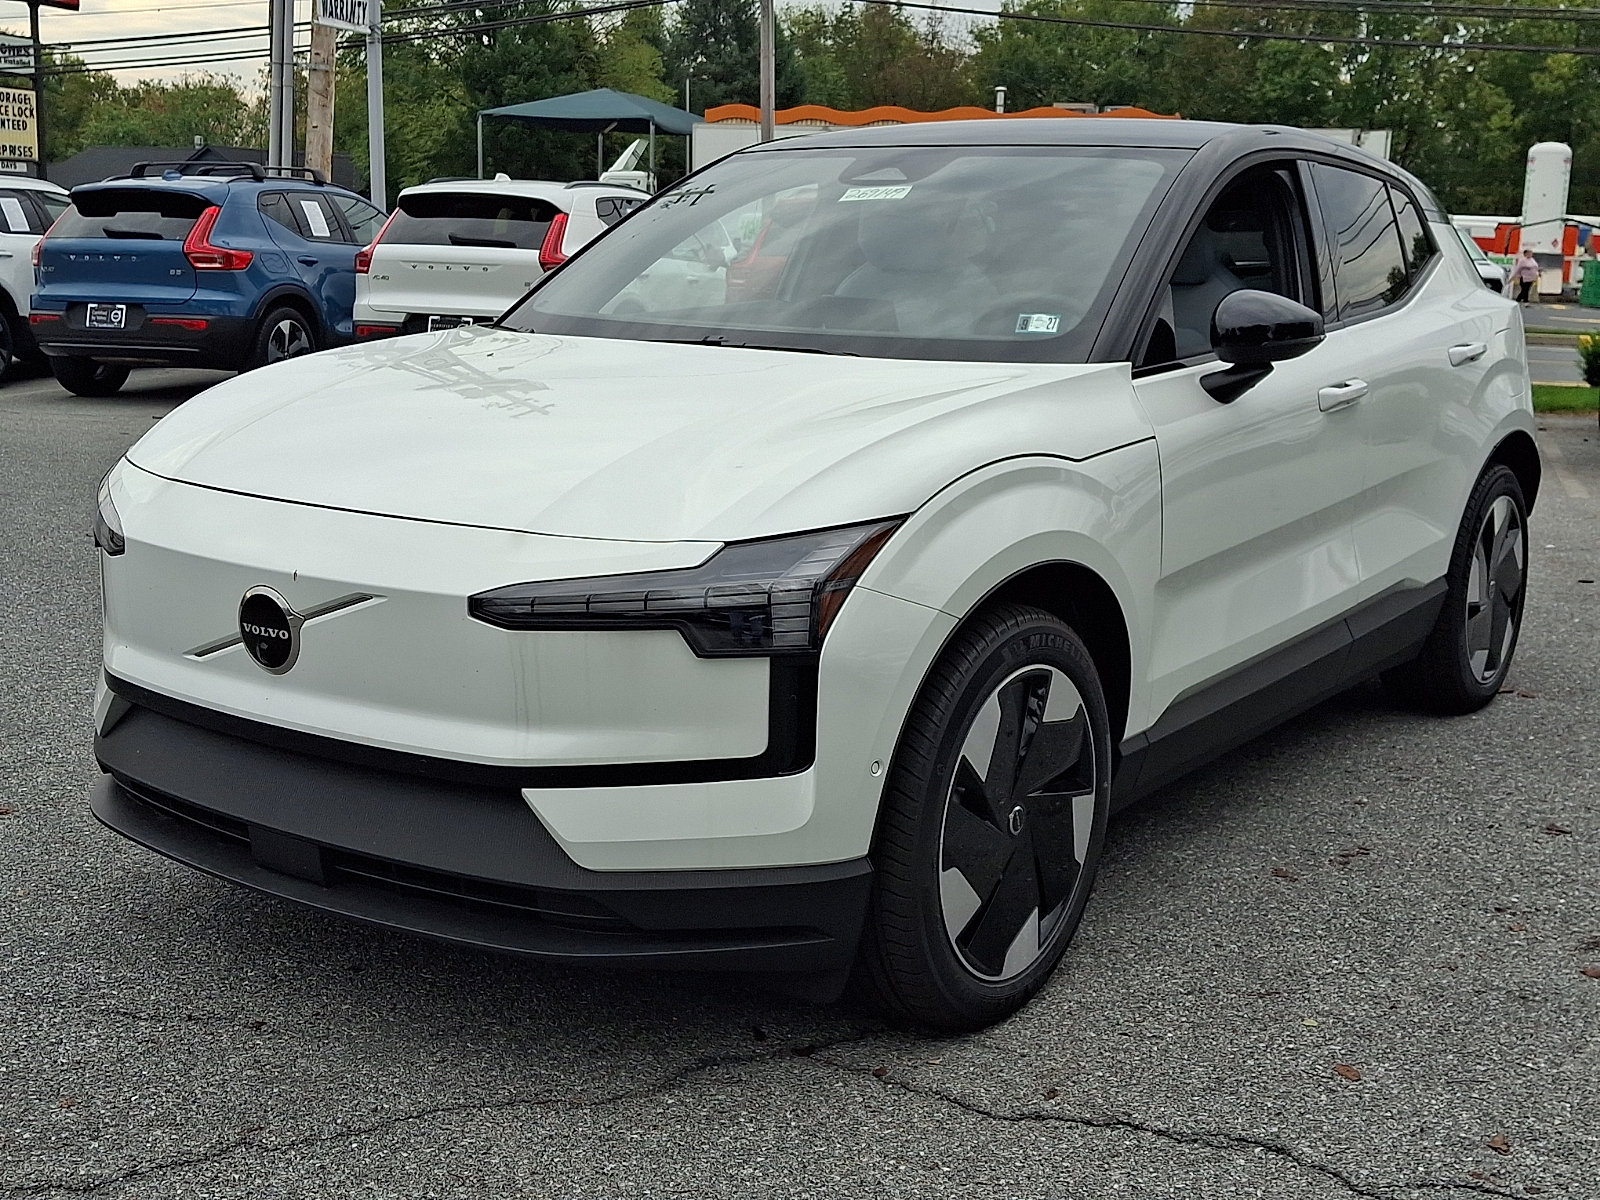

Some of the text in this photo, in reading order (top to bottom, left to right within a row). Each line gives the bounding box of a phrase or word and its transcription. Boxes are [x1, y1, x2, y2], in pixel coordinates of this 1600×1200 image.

[12, 106, 35, 119] LOCK
[0, 144, 33, 158] PRISES
[69, 254, 137, 262] VOLVO
[411, 264, 489, 272] VOLVO
[1046, 317, 1058, 331] 27
[242, 622, 289, 640] VOLVO
